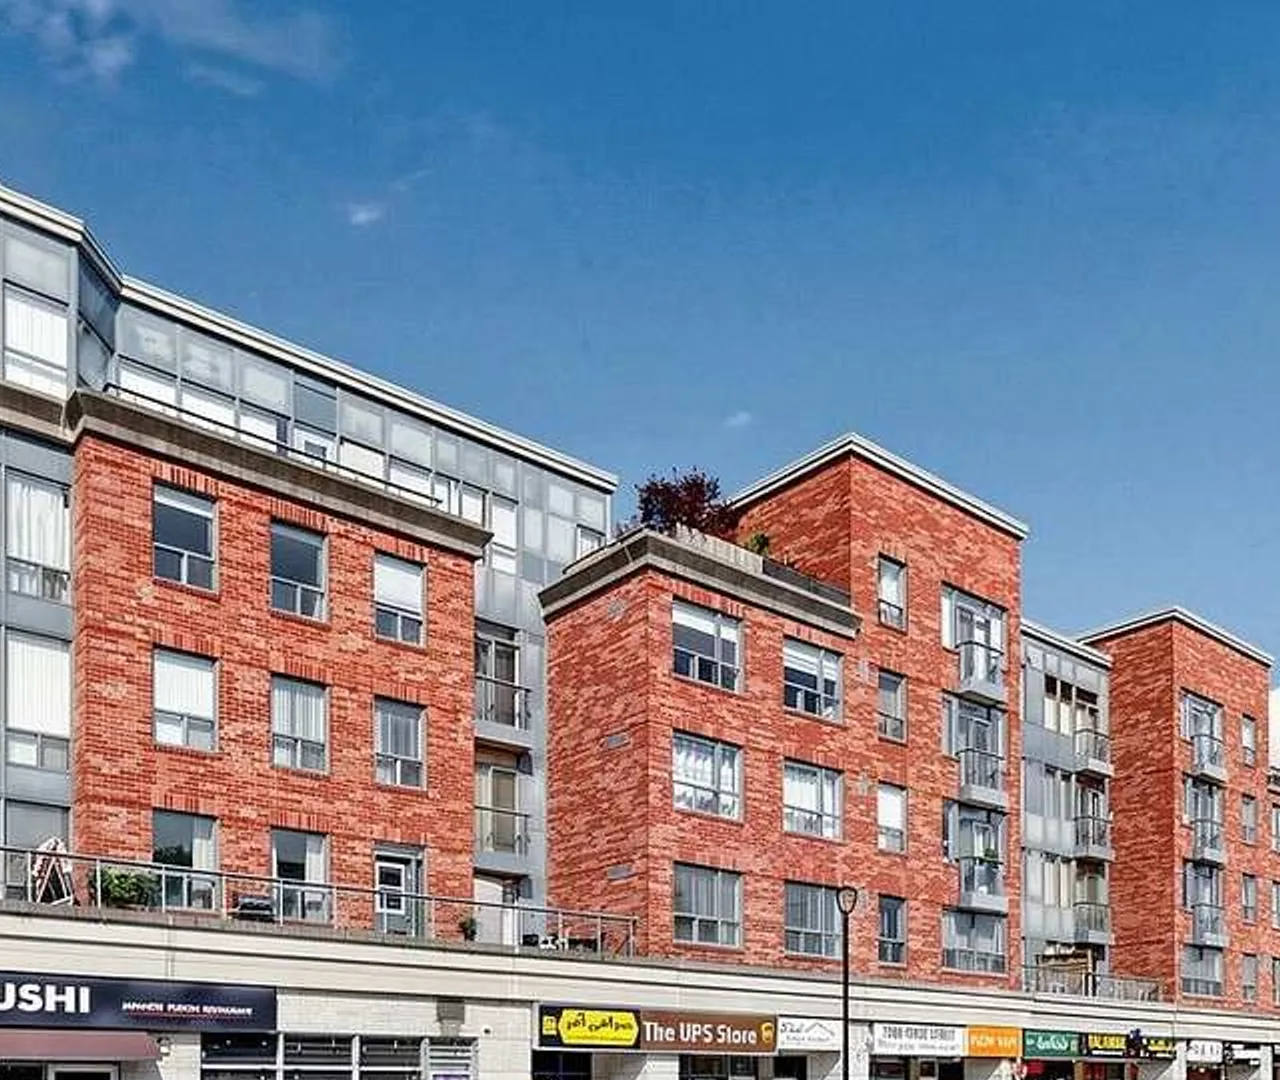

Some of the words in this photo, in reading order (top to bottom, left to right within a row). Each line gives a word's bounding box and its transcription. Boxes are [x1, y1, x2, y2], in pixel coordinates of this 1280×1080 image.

[642, 1021, 676, 1042] The
[679, 1022, 714, 1043] UPS
[716, 1024, 758, 1044] Store
